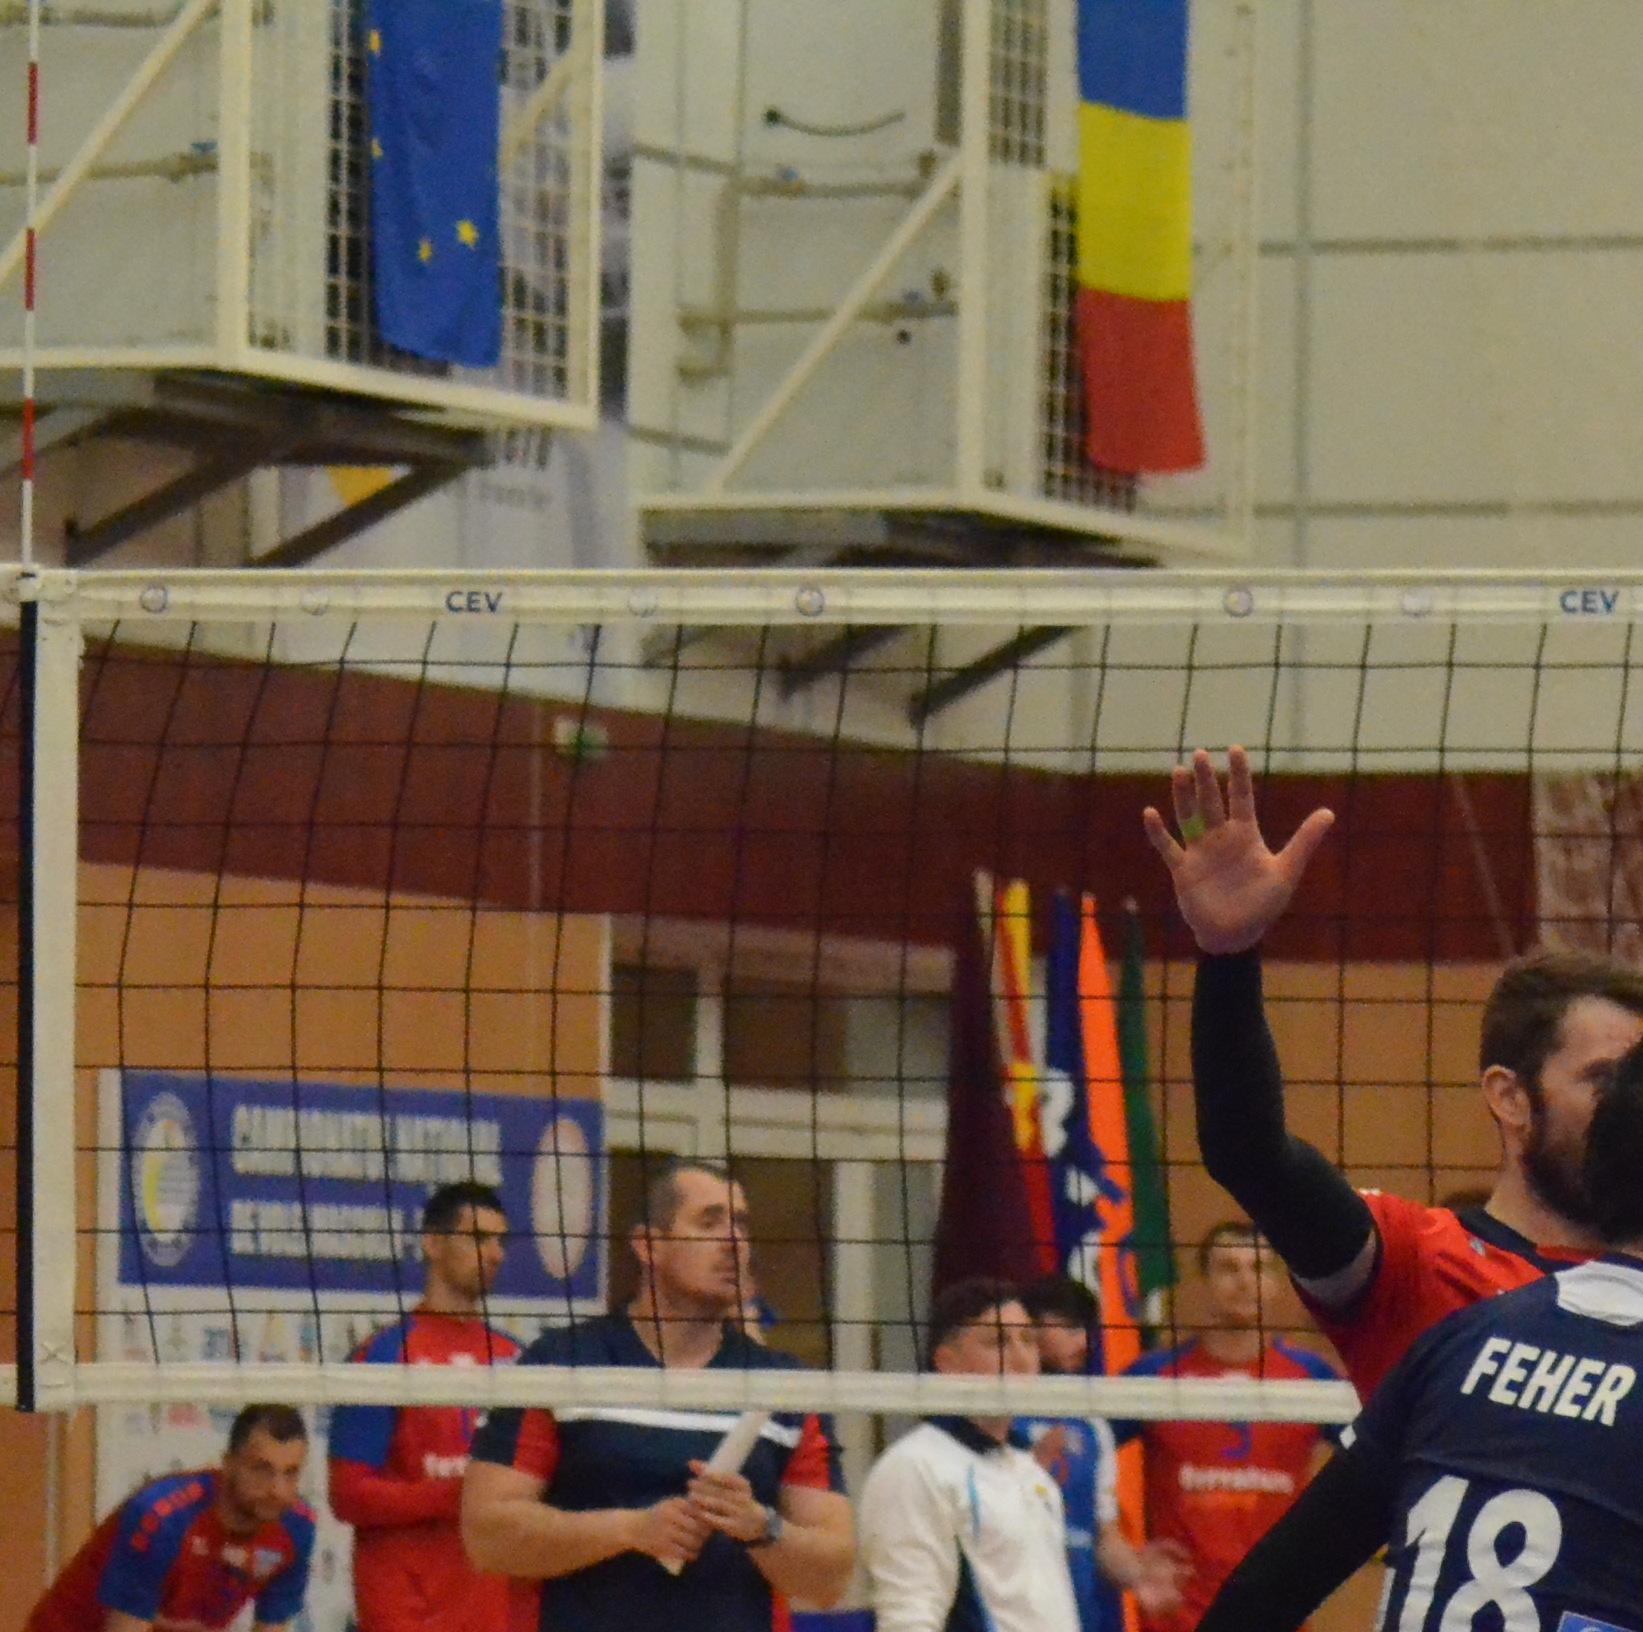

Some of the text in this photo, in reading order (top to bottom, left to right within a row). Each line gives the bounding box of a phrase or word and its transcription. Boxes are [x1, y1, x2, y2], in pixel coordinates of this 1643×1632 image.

[445, 591, 502, 613] CEV
[1559, 590, 1621, 615] CEV
[1460, 1336, 1637, 1427] FEHER
